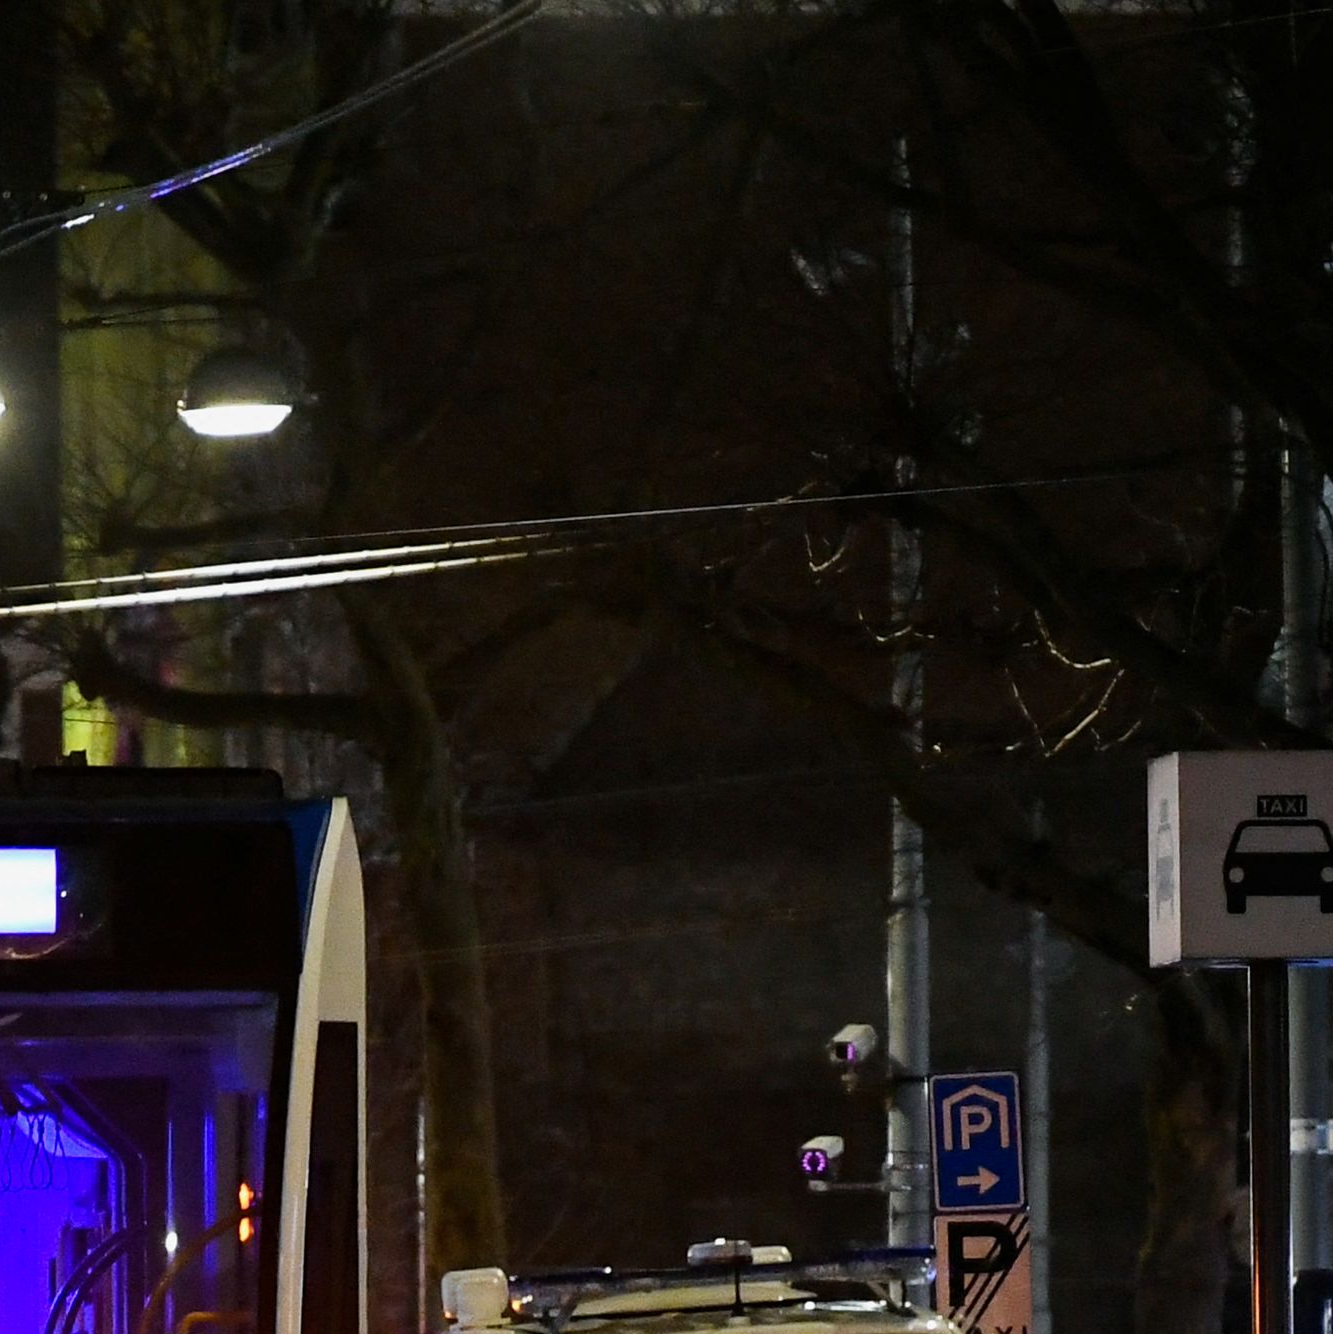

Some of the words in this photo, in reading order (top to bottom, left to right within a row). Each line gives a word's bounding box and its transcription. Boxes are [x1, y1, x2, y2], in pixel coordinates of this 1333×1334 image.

[1260, 798, 1305, 814] TAXI
[961, 1106, 992, 1150] P
[948, 1221, 1017, 1307] P
